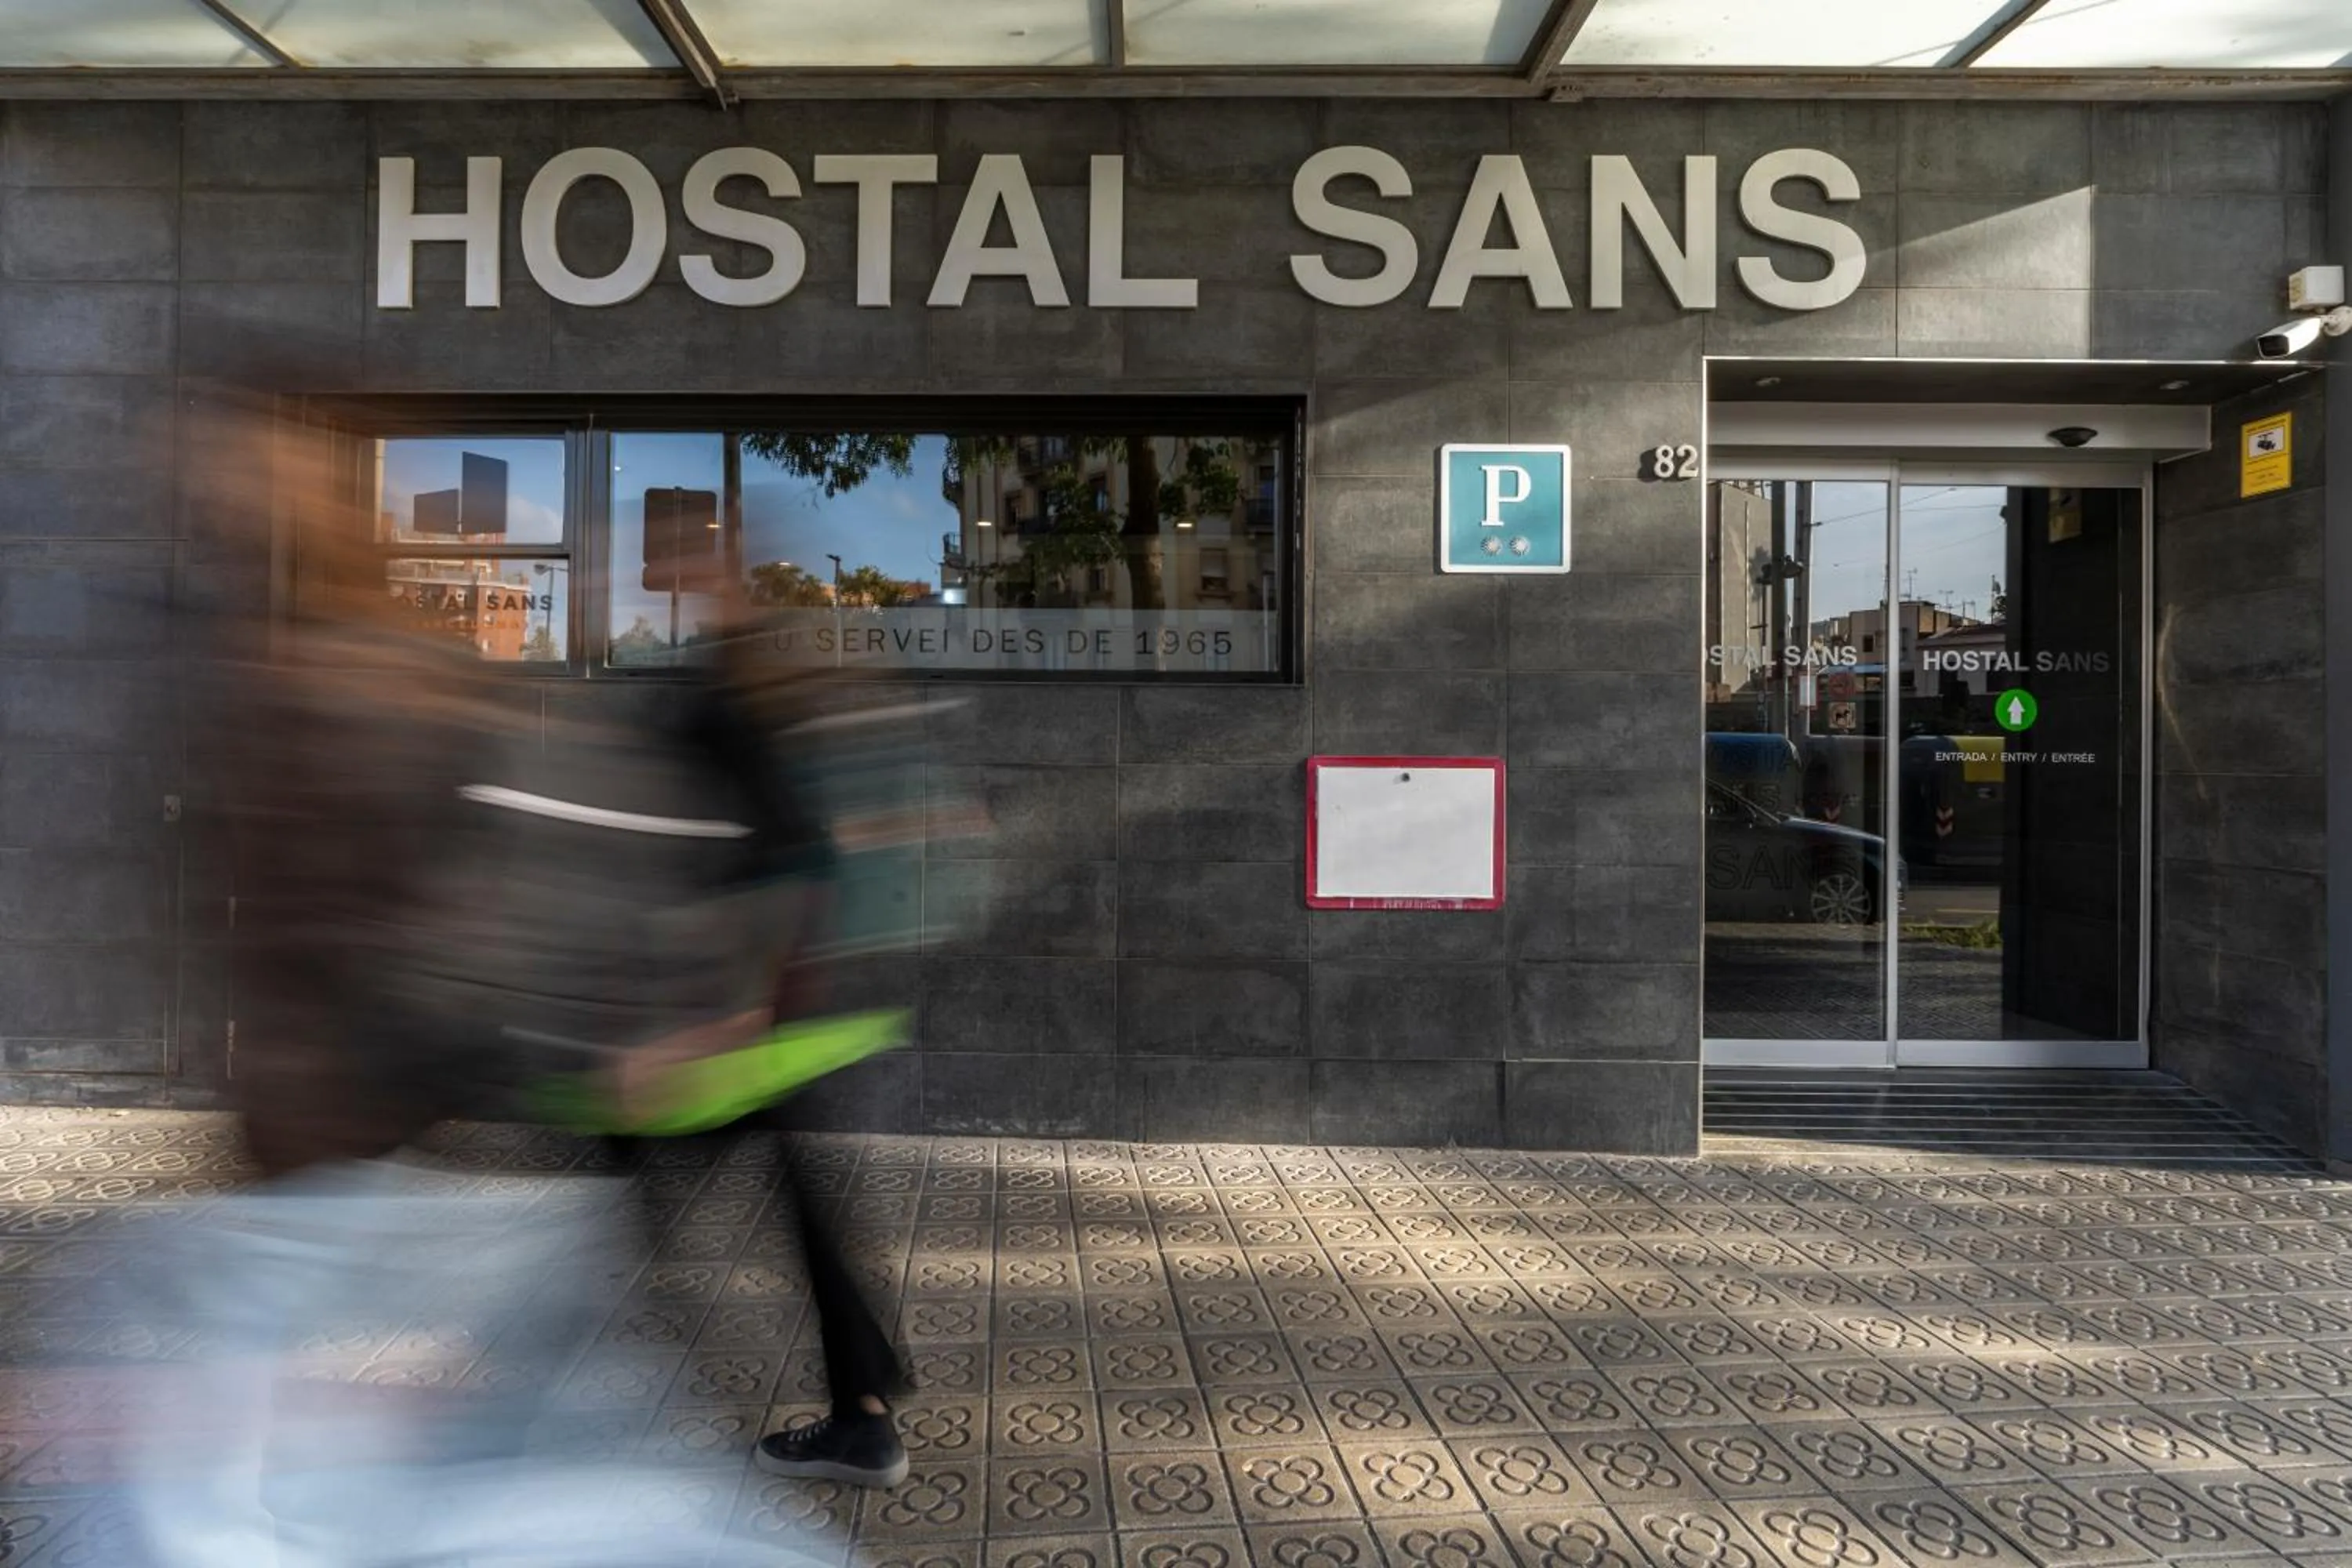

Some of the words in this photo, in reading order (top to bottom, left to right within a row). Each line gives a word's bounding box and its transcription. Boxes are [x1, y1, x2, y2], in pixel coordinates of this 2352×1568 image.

[376, 147, 1199, 307] HOSTAL
[1290, 145, 1867, 310] SANS
[1653, 444, 1699, 478] 82
[1480, 464, 1531, 526] P
[486, 594, 553, 611] SANS
[815, 628, 949, 654] SERVEI
[973, 629, 1044, 654] DES
[1068, 630, 1113, 655] DE
[1134, 630, 1233, 655] 1965
[1703, 644, 1777, 666] STAL
[1784, 644, 1857, 666] SANS
[1922, 650, 2029, 672] HOSTAL
[2036, 650, 2110, 673] SANS
[1935, 751, 1988, 763] ENTRADA
[2000, 752, 2038, 764] ENTRY
[2051, 750, 2096, 764] ENTRÉE
